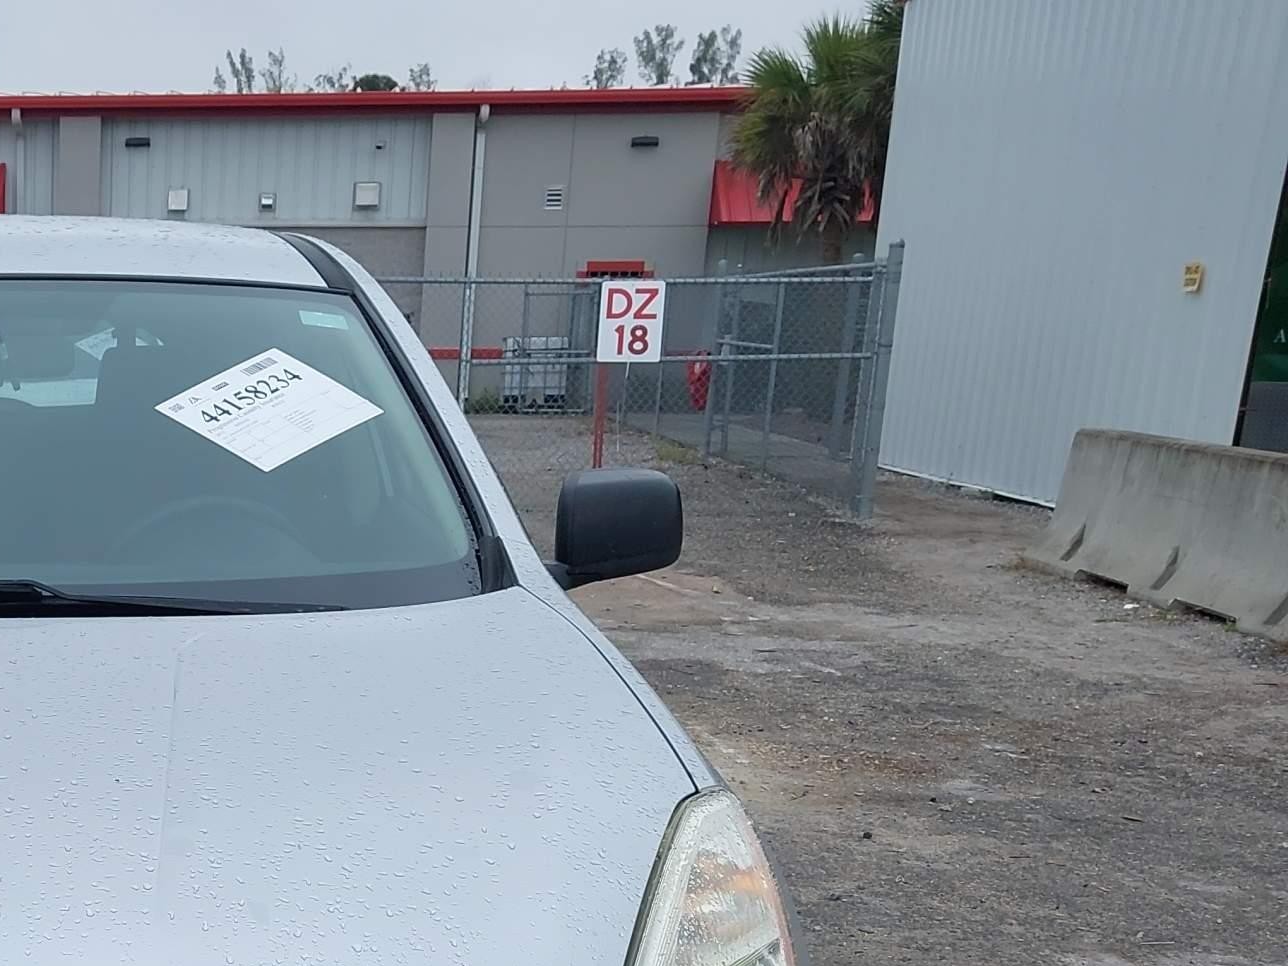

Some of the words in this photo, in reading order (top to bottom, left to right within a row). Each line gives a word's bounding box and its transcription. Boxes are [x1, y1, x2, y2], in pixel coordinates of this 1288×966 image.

[606, 288, 659, 319] DZ
[615, 324, 649, 355] 18
[201, 368, 303, 423] 44158234
